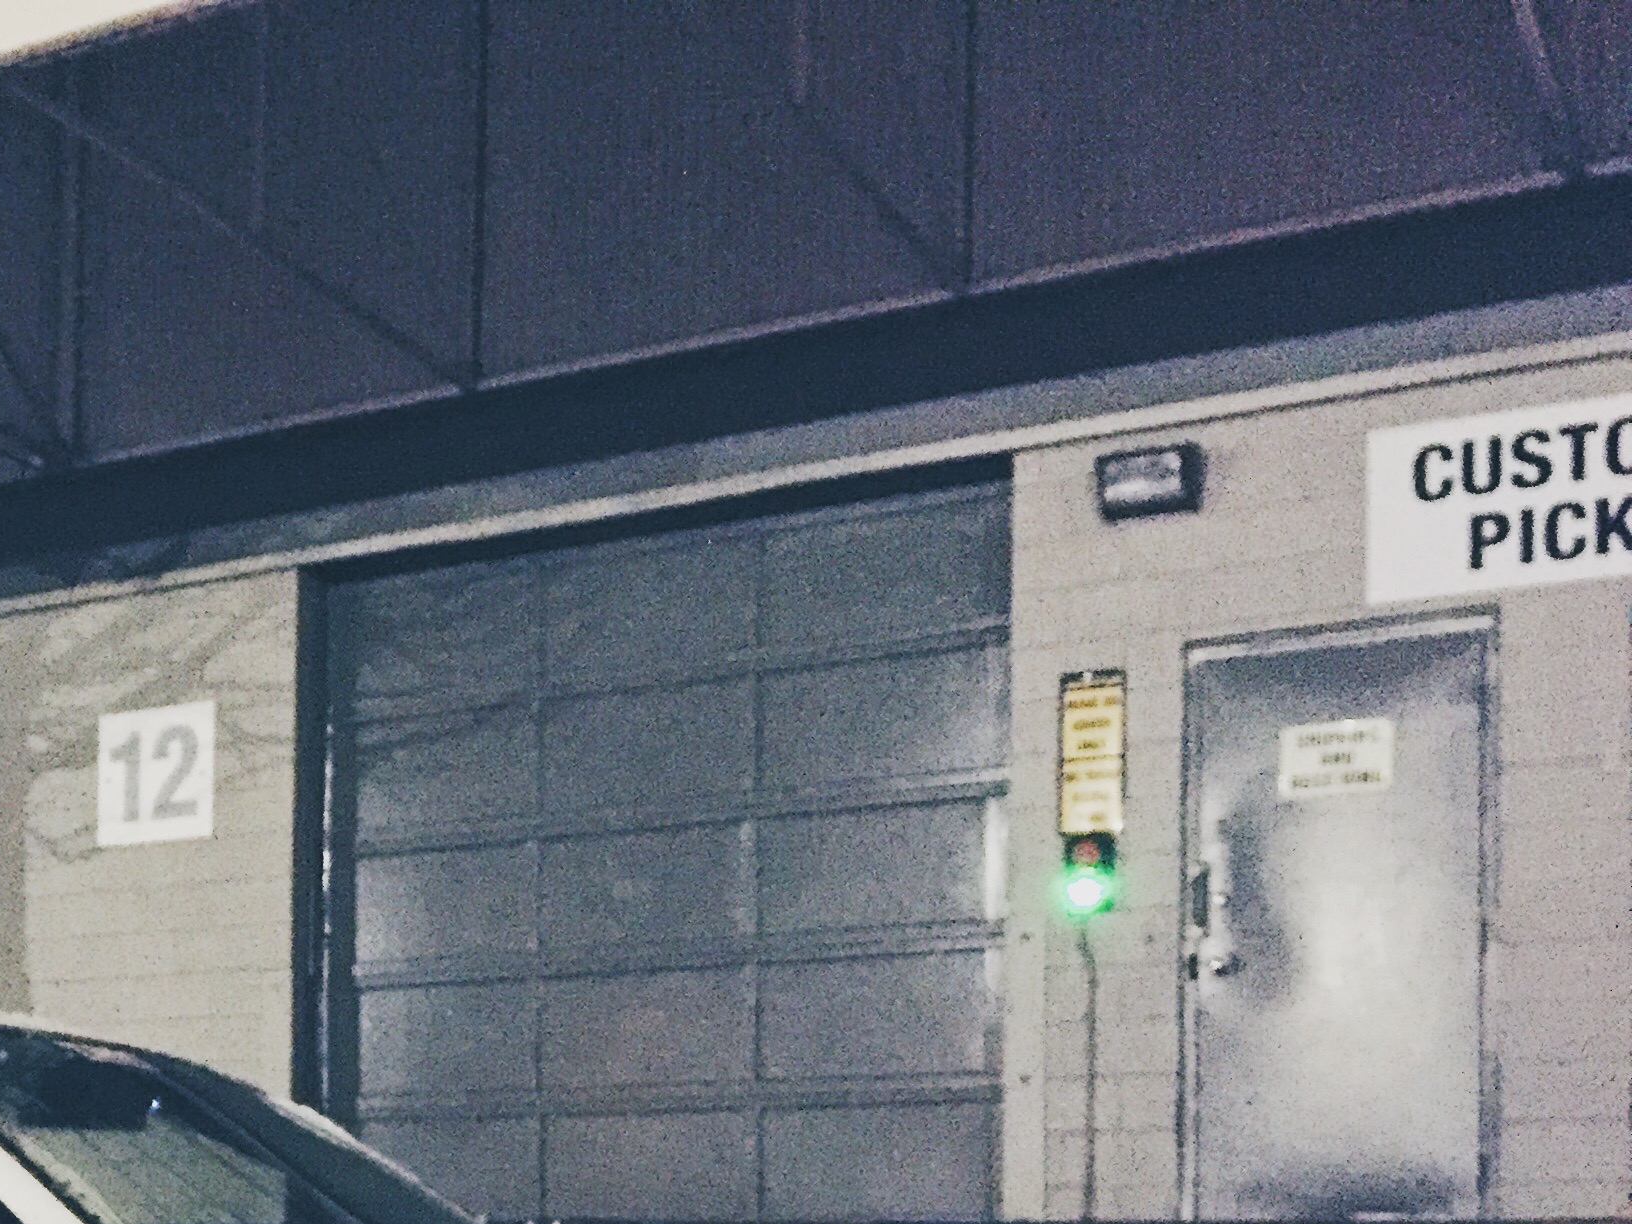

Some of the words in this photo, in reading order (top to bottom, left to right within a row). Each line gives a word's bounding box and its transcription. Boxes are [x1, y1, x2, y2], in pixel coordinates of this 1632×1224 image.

[1413, 415, 1632, 502] CUSTO
[1470, 494, 1632, 570] PICK
[109, 724, 199, 822] 12
